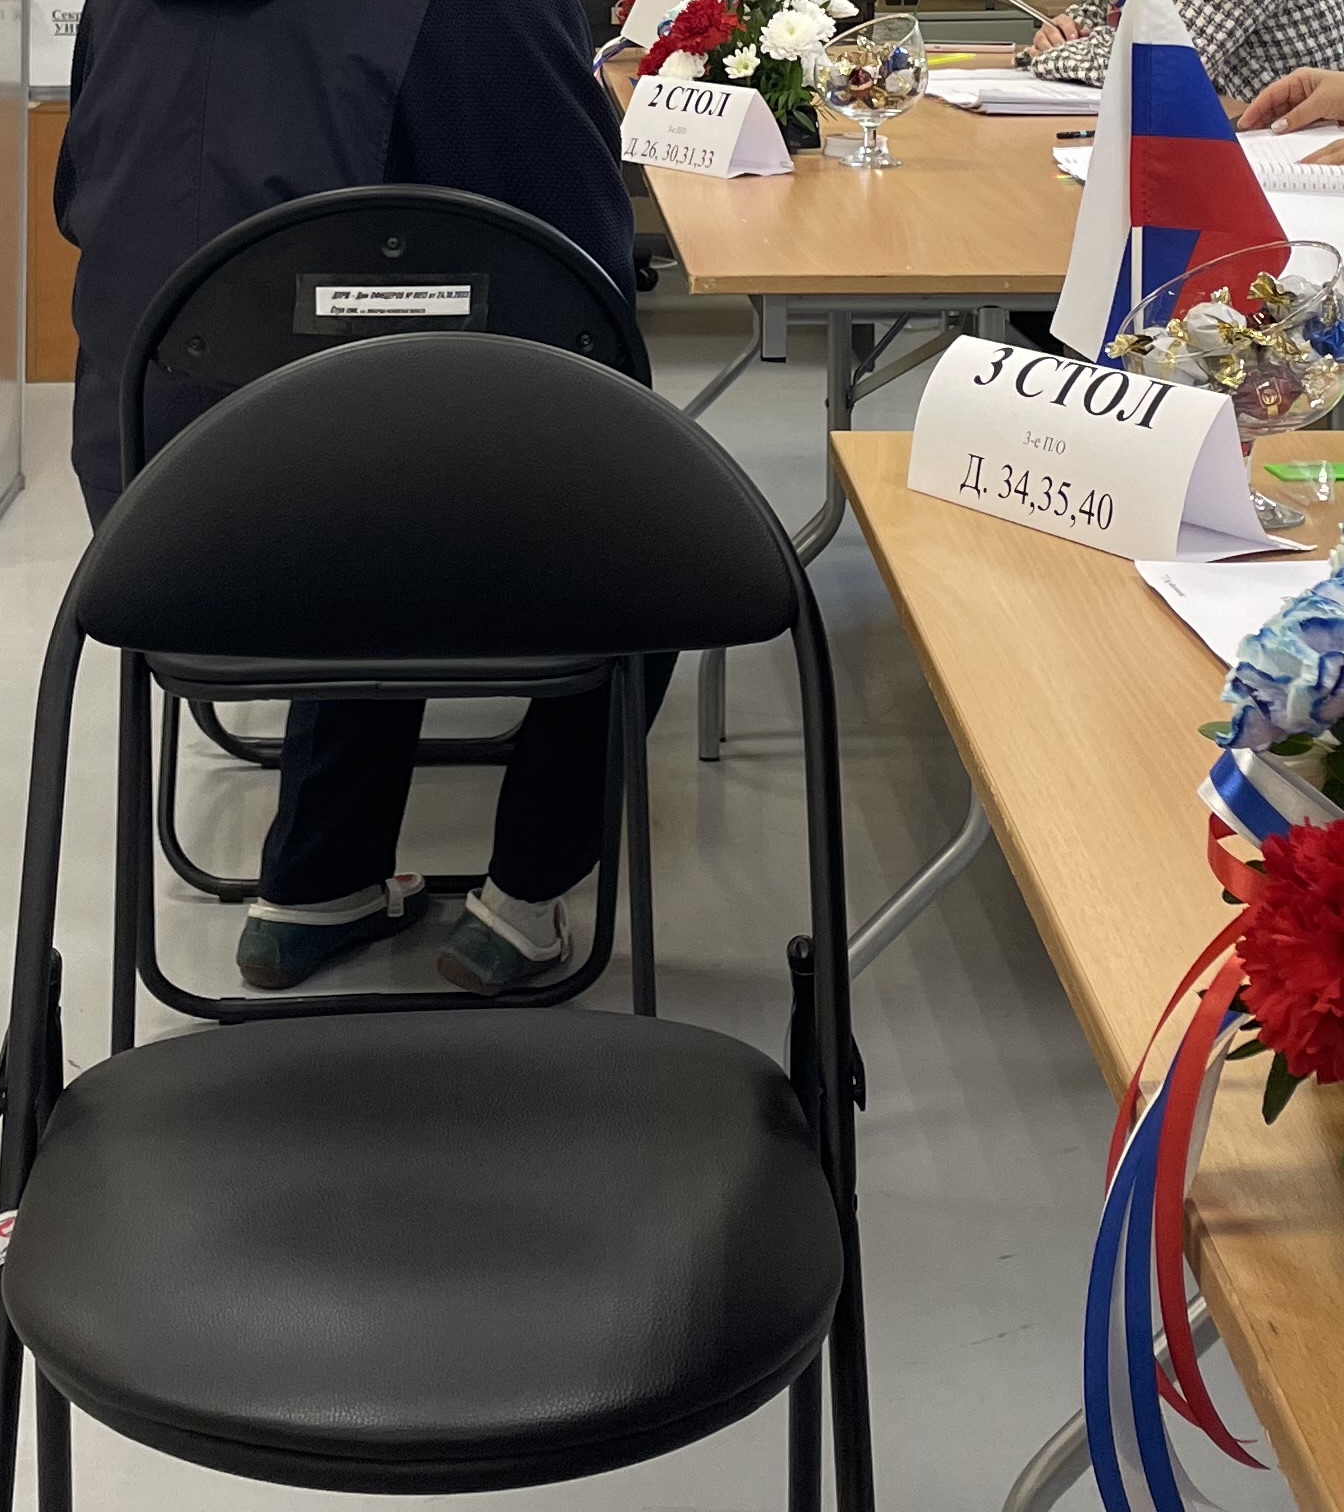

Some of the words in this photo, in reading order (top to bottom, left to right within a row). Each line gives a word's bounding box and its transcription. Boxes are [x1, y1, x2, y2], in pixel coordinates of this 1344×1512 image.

[647, 83, 663, 108] 2
[666, 86, 732, 117] СТОЛ
[641, 139, 659, 161] 26,
[662, 144, 715, 168] 30,31,33
[973, 346, 1015, 386] 3
[1016, 356, 1177, 430] СТОЛ
[959, 452, 988, 497] Д.
[997, 464, 1114, 531] 34,35,40
